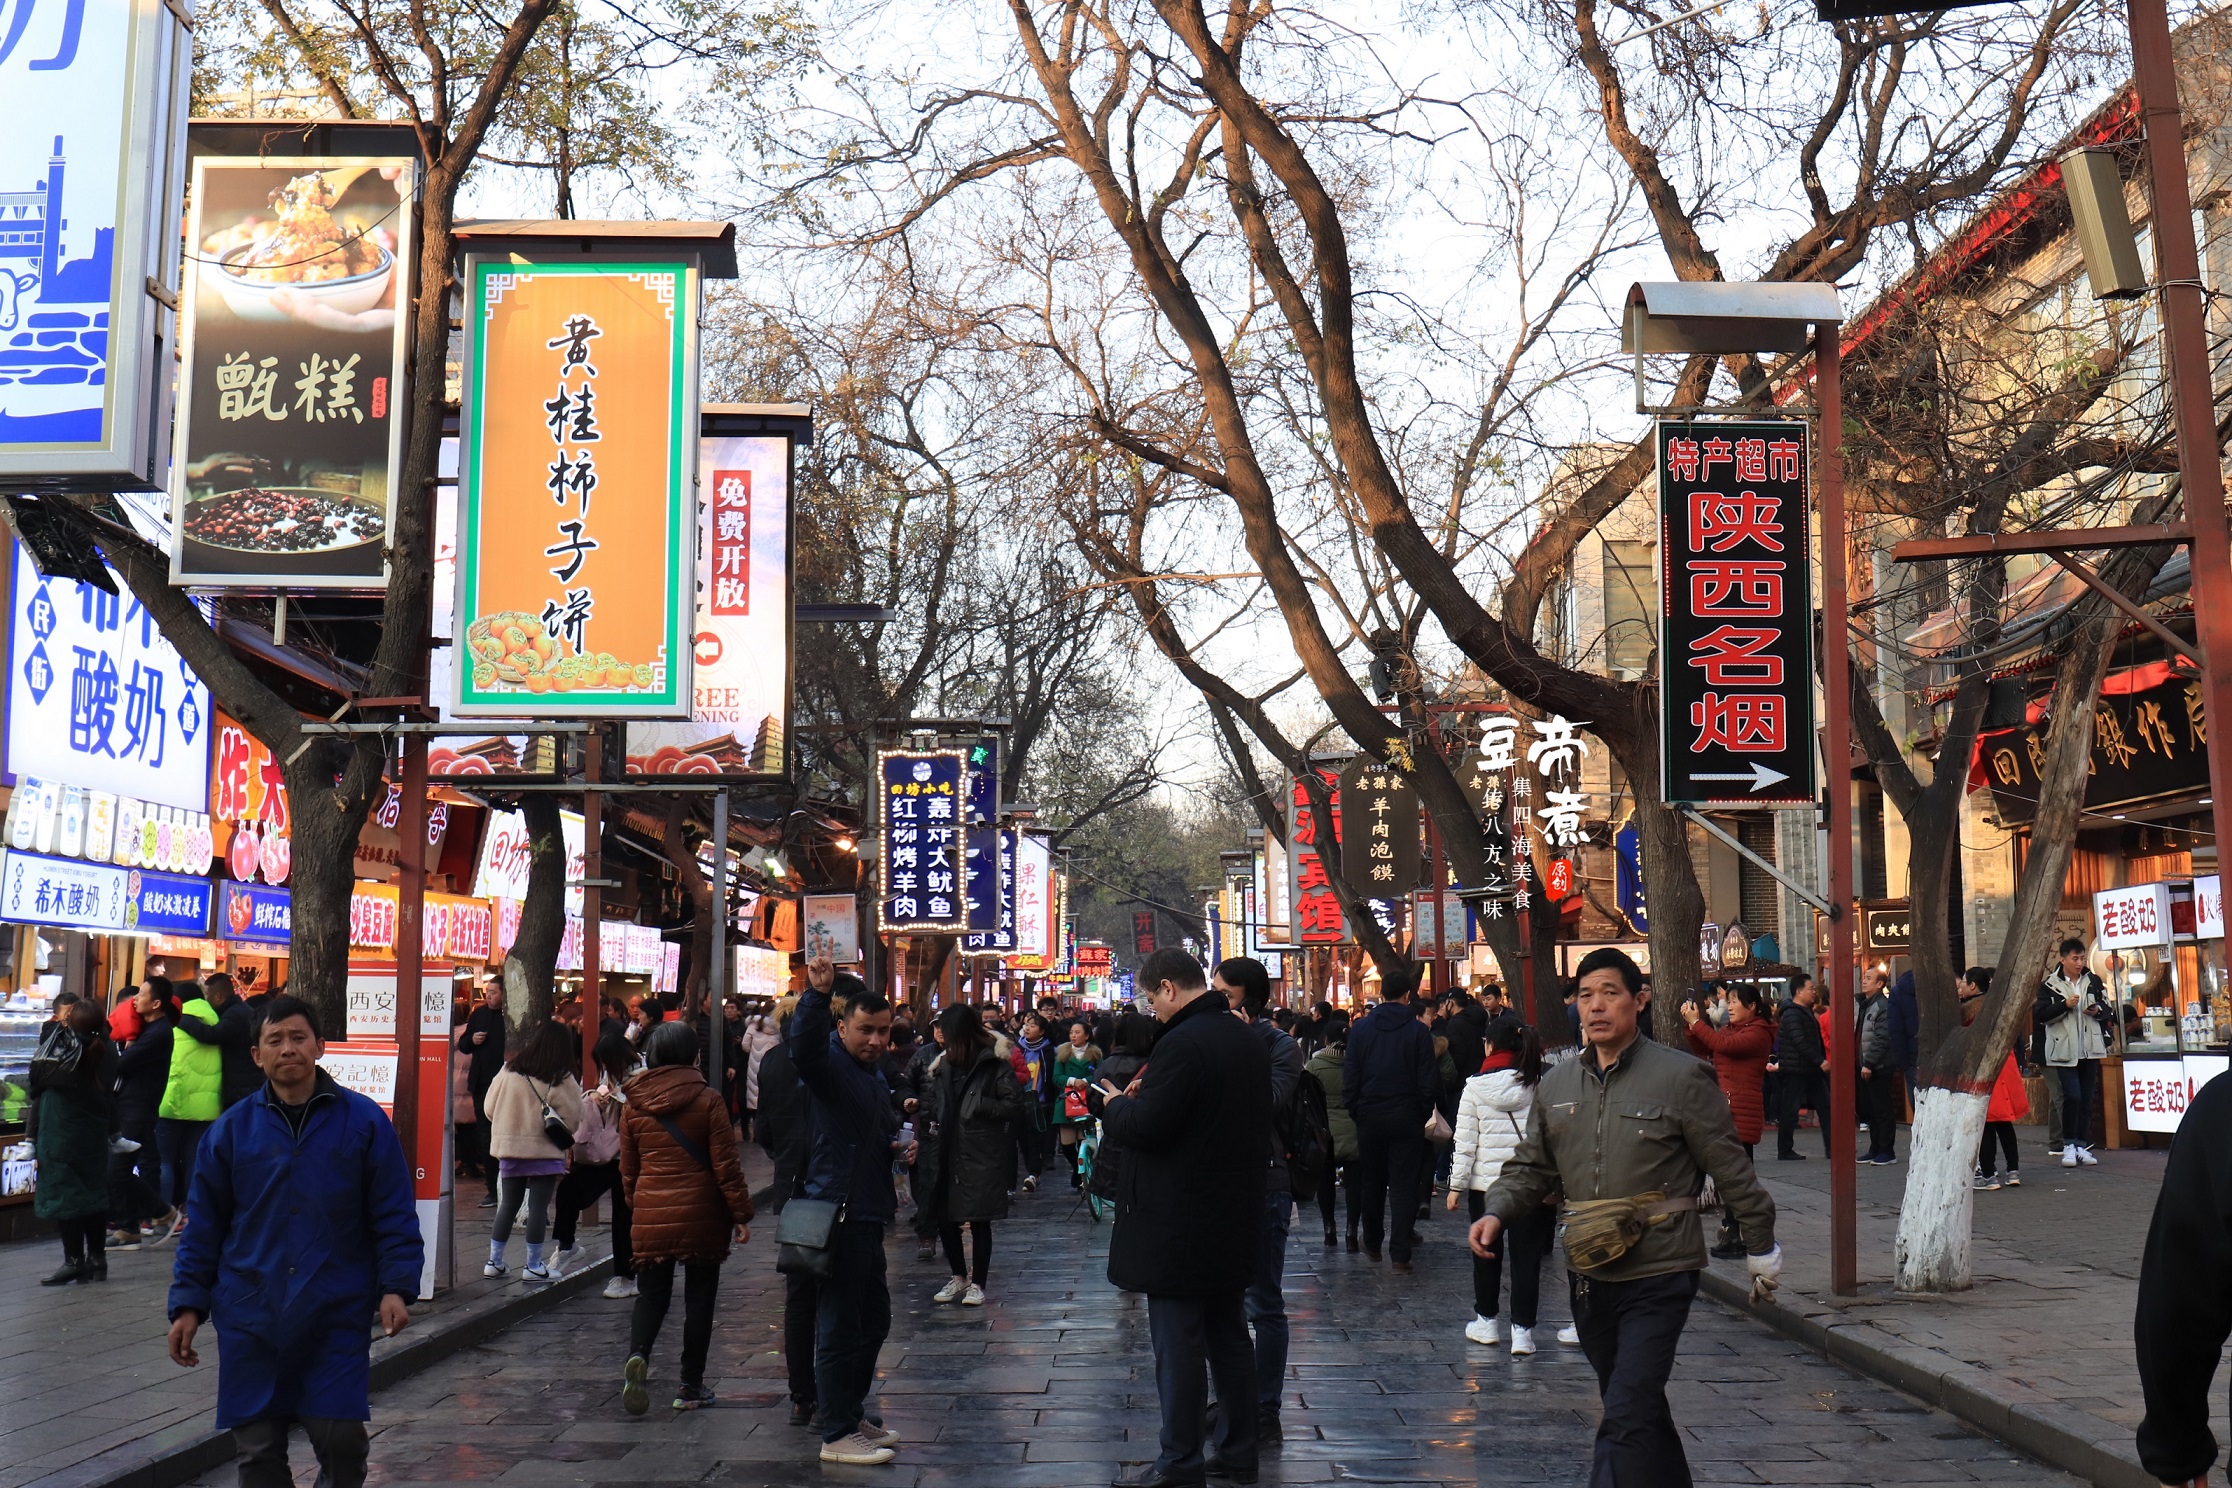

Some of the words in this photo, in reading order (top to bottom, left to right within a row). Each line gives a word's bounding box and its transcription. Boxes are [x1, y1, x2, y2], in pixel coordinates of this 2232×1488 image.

[216, 351, 364, 424] 甑糕
[1668, 437, 1799, 482] 特产超市
[541, 314, 604, 657] 黄桂柿子饼
[714, 477, 748, 609] 免费开放
[1687, 490, 1787, 754] 陕西名烟
[69, 644, 166, 769] 酸奶
[1476, 716, 1521, 771] 豆
[891, 781, 954, 796] 回坊小吃
[1469, 775, 1507, 790] 老孫
[892, 797, 918, 918] 红柳烤羊肉
[927, 796, 954, 918] 轰炸大鱿鱼
[1511, 776, 1533, 909] 集四海美食
[35, 878, 100, 917] 希木酸奶
[1551, 861, 1567, 892] 原创
[143, 891, 201, 919] 酸奶冰激凌卷
[2103, 898, 2156, 937] 老酸奶
[349, 991, 446, 1012] 西安憶
[349, 1014, 442, 1024] 西安历史览馆
[2130, 1075, 2185, 1114] 老酸奶
